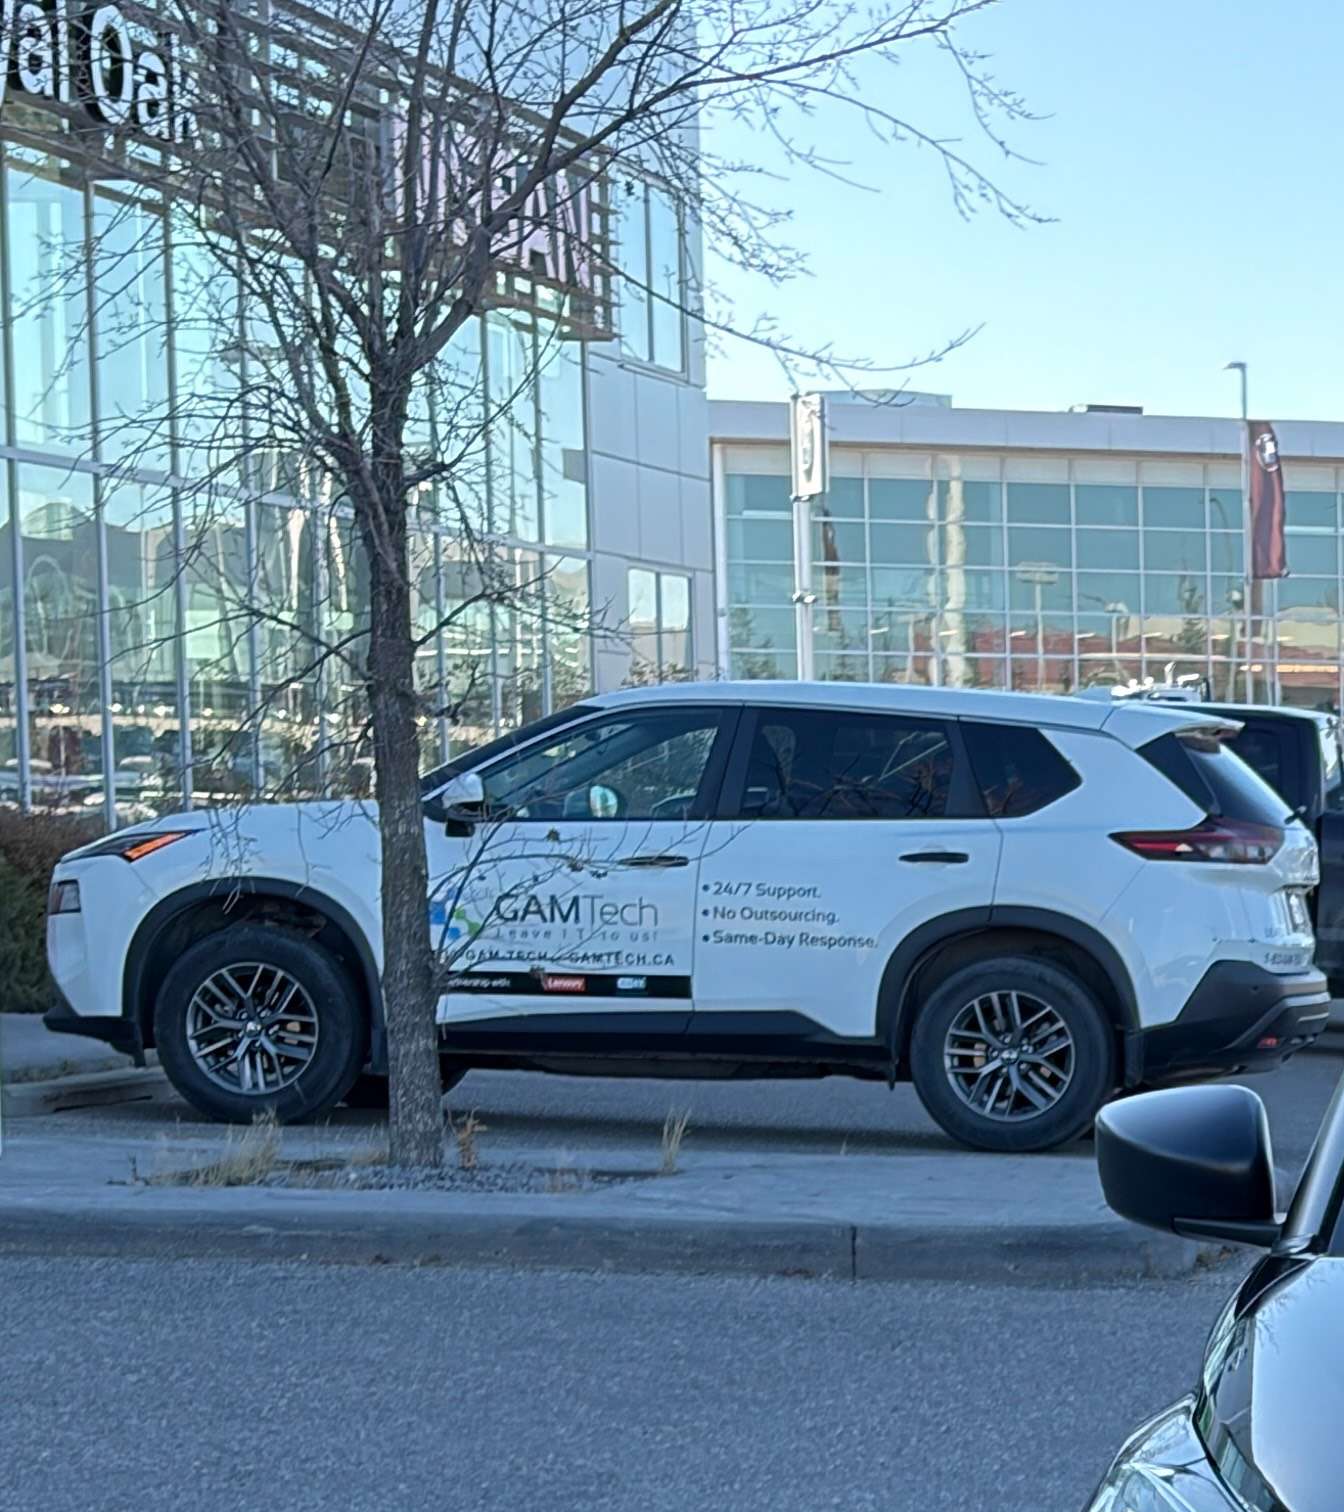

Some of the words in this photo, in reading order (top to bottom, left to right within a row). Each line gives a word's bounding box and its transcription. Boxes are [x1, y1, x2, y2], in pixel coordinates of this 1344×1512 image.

[713, 881, 752, 896] 24/7
[755, 882, 821, 900] Support.
[497, 894, 659, 927] GAMTech
[713, 906, 736, 920] No
[740, 906, 840, 925] Outsourcing.
[713, 930, 795, 949] Same-Day
[799, 932, 879, 950] Response.
